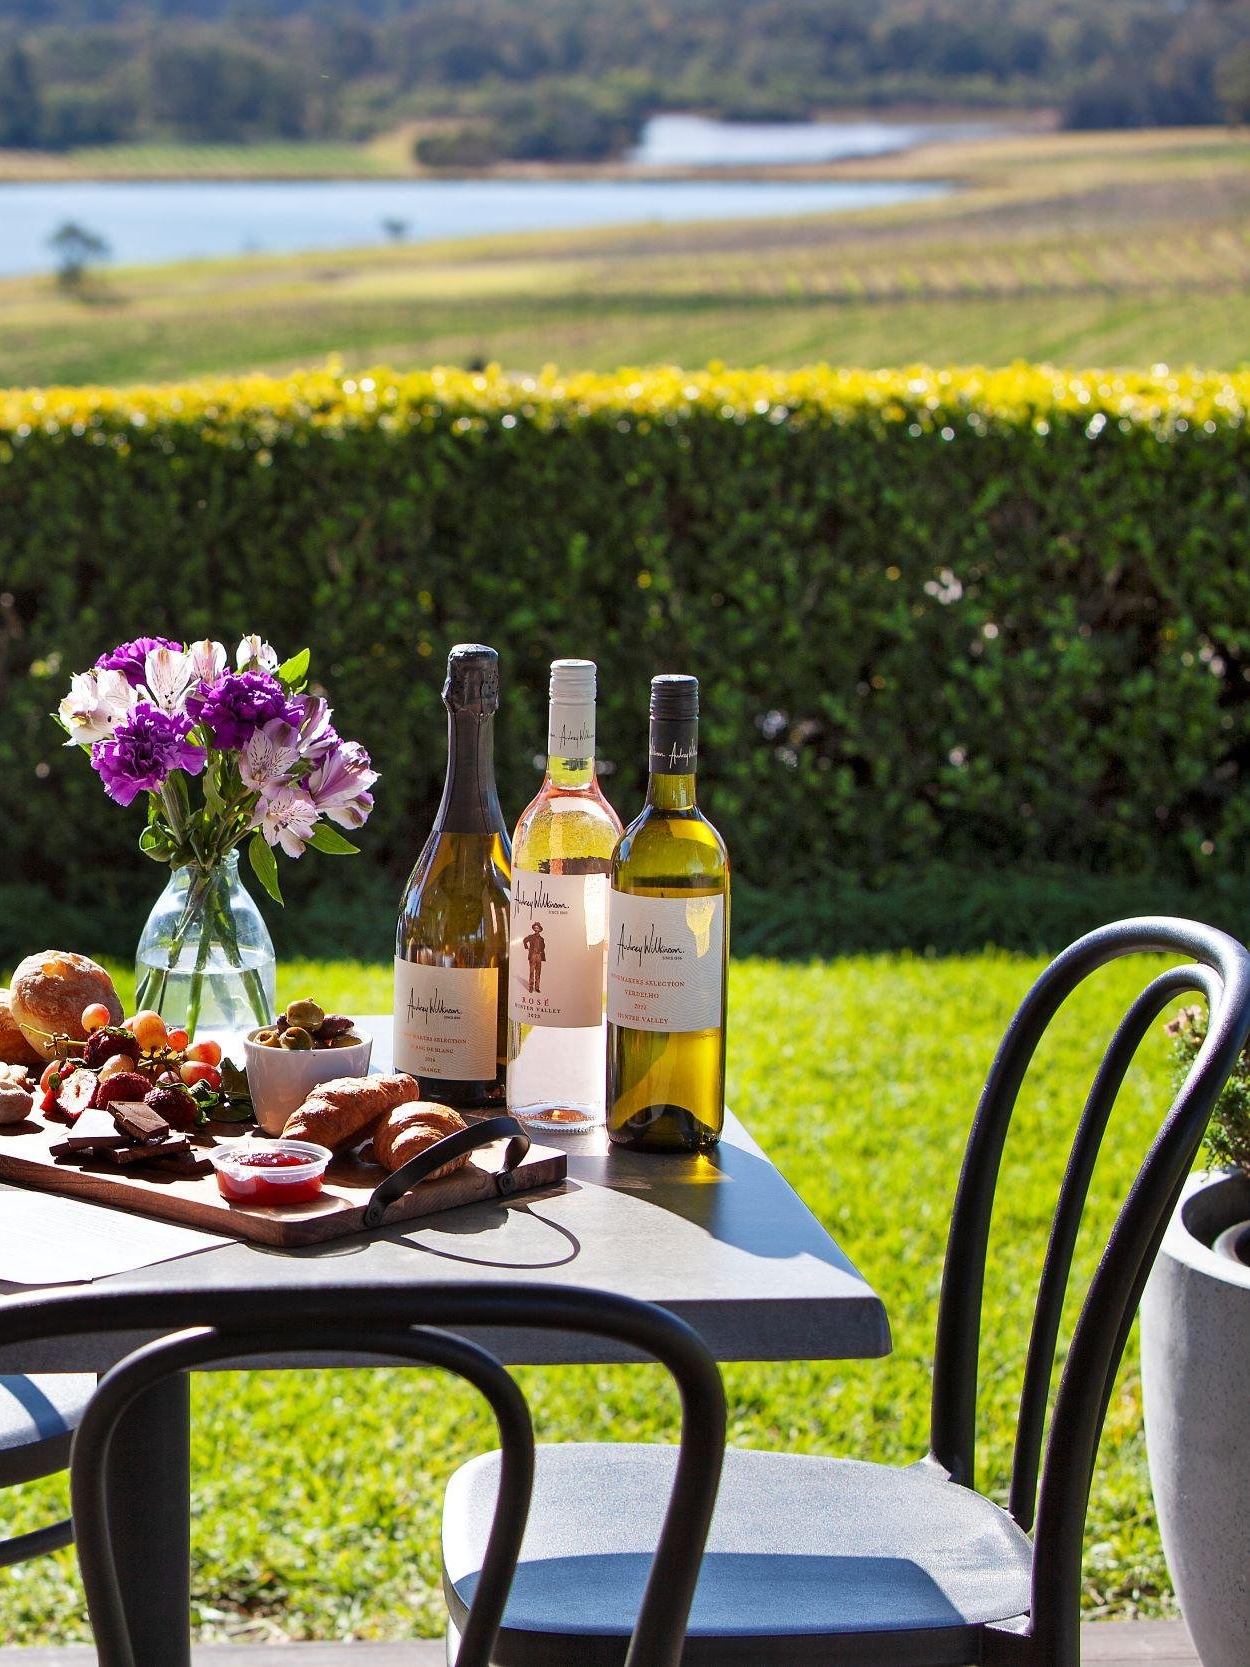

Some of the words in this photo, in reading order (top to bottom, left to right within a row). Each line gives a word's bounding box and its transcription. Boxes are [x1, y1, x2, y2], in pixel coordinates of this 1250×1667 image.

[513, 880, 534, 920] Audrey
[617, 923, 642, 967] Audrey
[624, 989, 659, 999] VERDELHO
[407, 987, 429, 1024] Audrey
[522, 995, 550, 1007] ROSÉ
[641, 1016, 669, 1024] VALLEY
[419, 1066, 442, 1074] ORANGE
